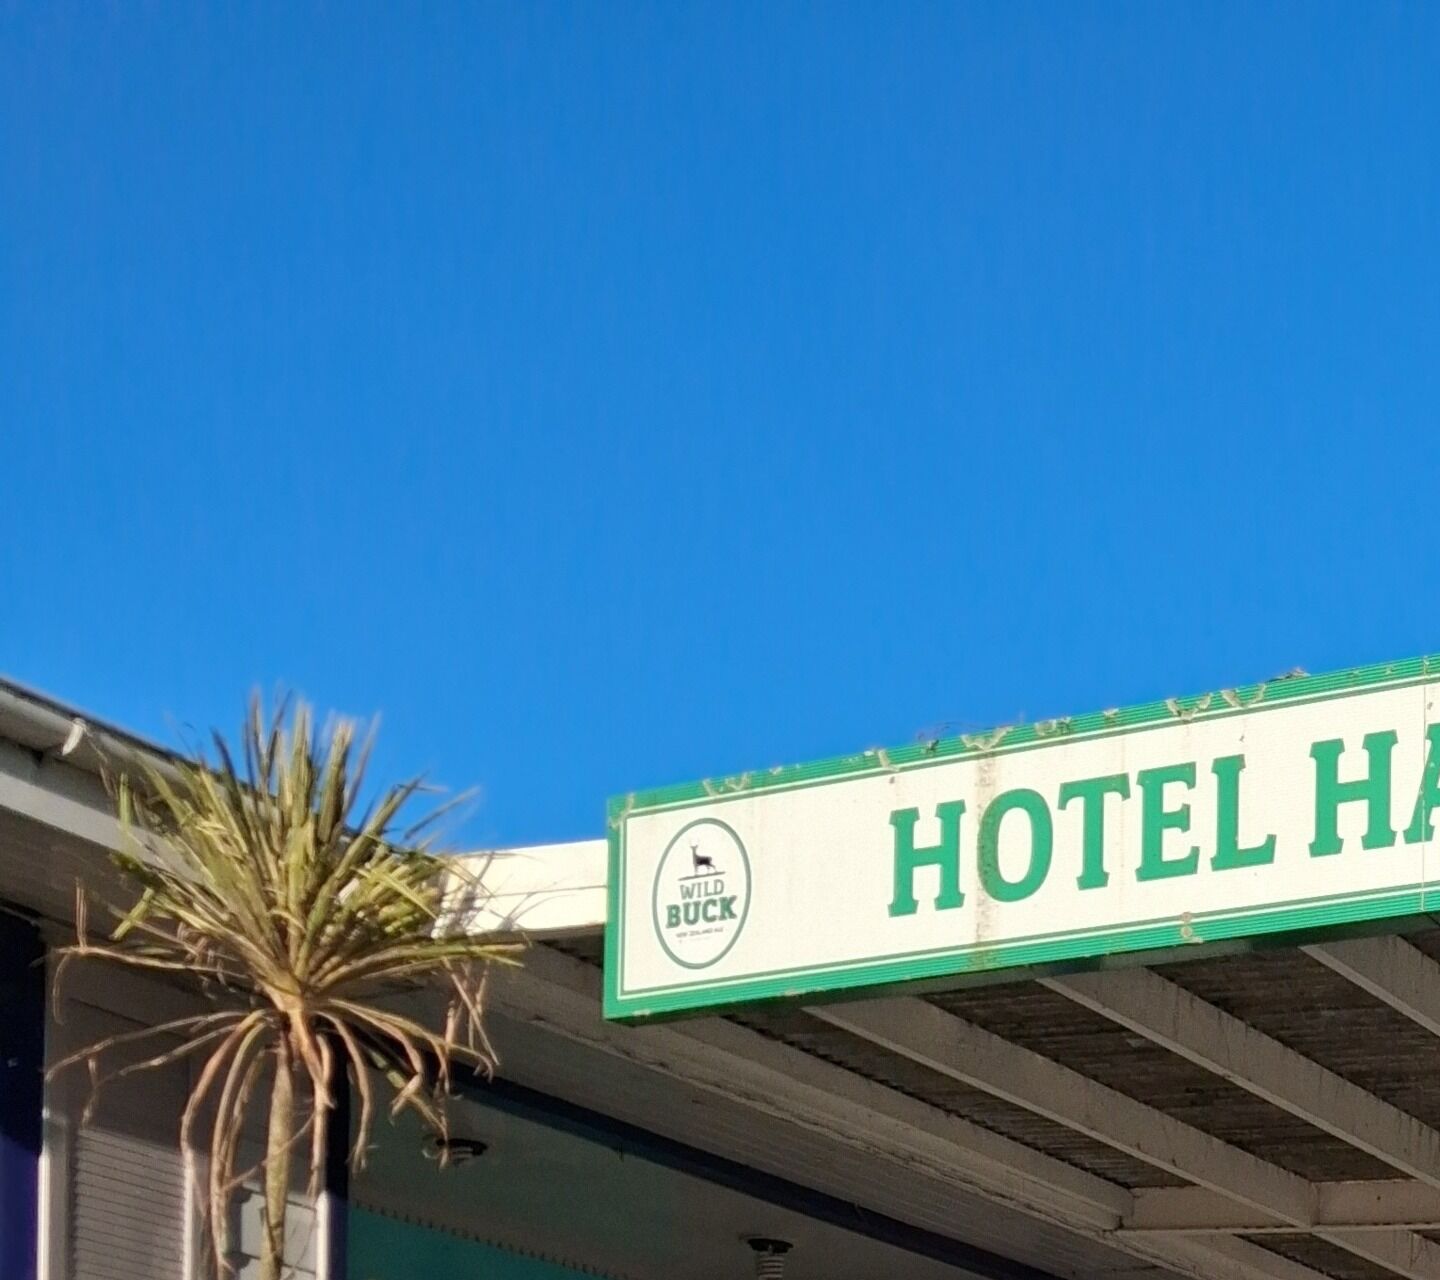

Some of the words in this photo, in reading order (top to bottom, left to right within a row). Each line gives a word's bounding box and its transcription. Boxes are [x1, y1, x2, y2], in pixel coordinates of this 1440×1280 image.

[887, 754, 1277, 918] HOTEL
[680, 880, 724, 899] WILD
[666, 896, 737, 928] BUCK
